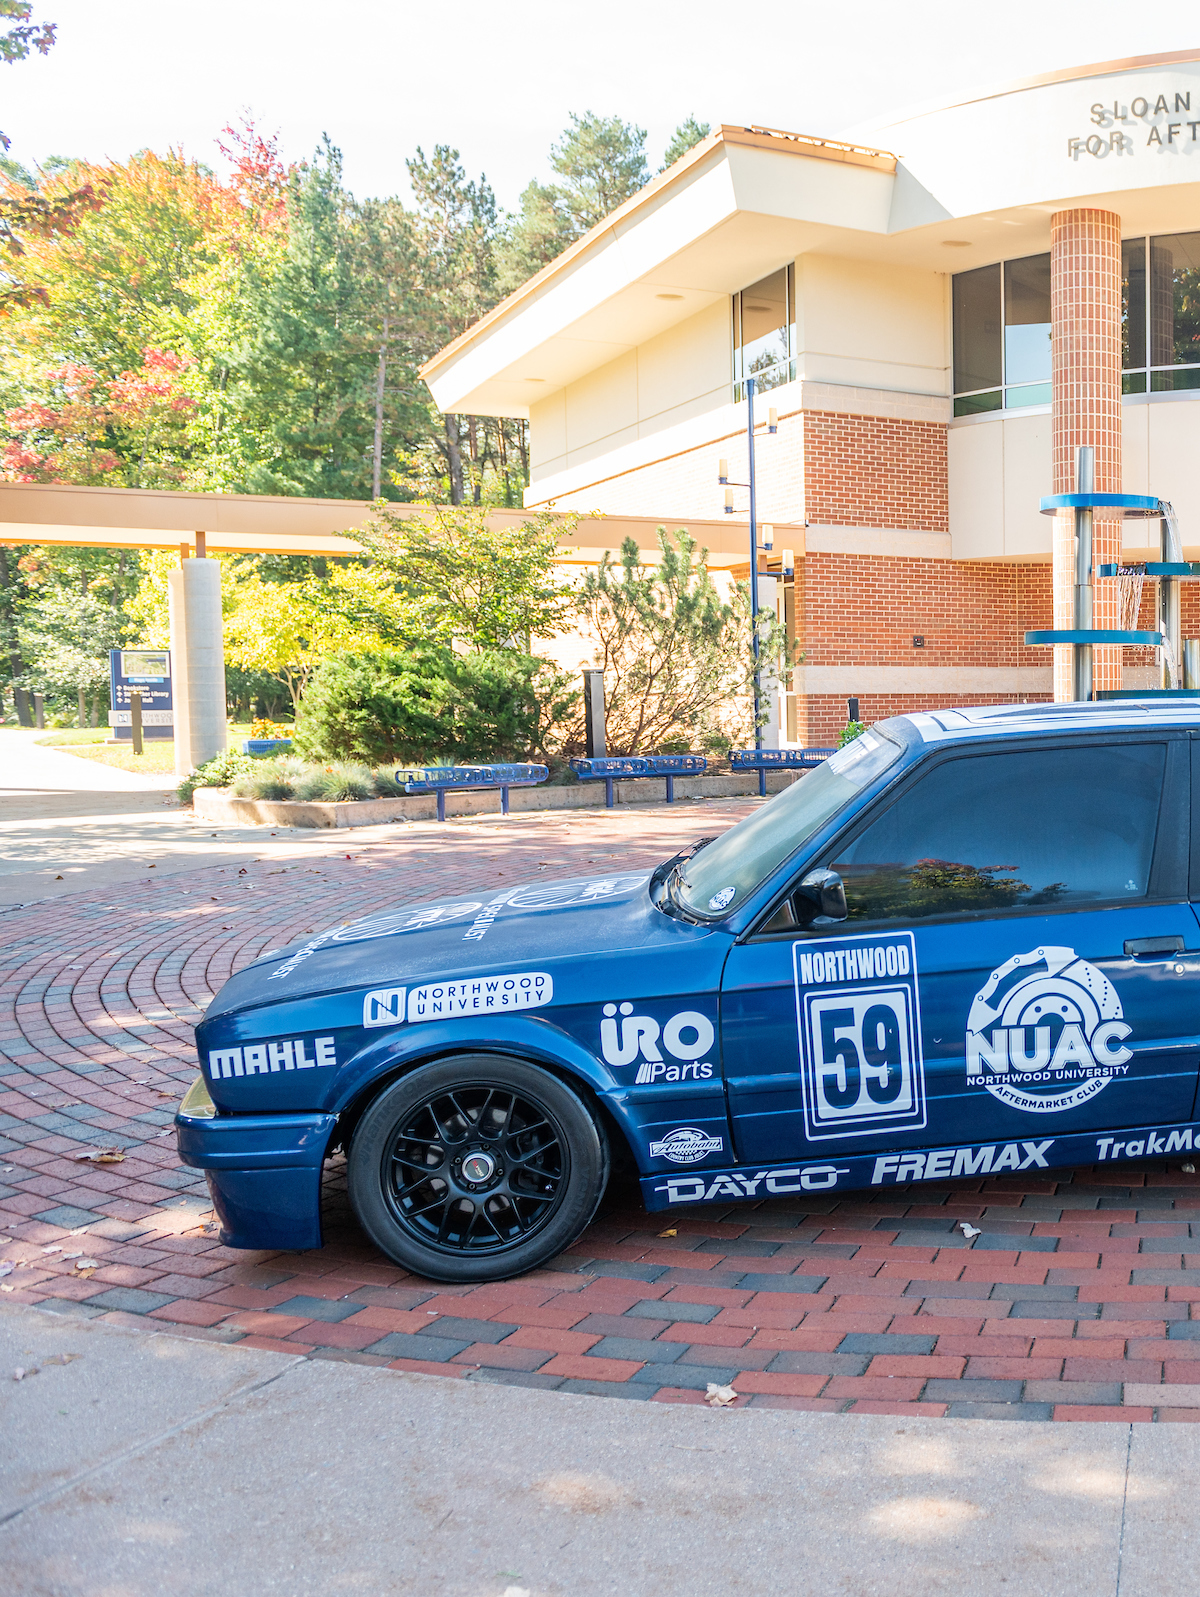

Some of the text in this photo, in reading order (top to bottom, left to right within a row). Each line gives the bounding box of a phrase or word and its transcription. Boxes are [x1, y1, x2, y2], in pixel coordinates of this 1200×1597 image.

[1090, 91, 1191, 125] SLOAN
[1068, 130, 1125, 158] FOR
[800, 945, 910, 985] NORTHWOOD
[417, 976, 545, 1001] NORTHWOOD
[417, 990, 544, 1015] UNIVERSITY
[208, 1036, 337, 1080] MAHLE
[819, 1003, 903, 1110] 59
[966, 1021, 1134, 1076] NUAC
[651, 1061, 713, 1083] Parts
[966, 1065, 1130, 1087] NORTHWOOD UNIVERSITY
[995, 1079, 1103, 1109] AFTERMARKET CLUB
[654, 1140, 721, 1153] Autobahn
[871, 1139, 1055, 1185] FREMAX
[667, 1165, 840, 1204] DAYCO
